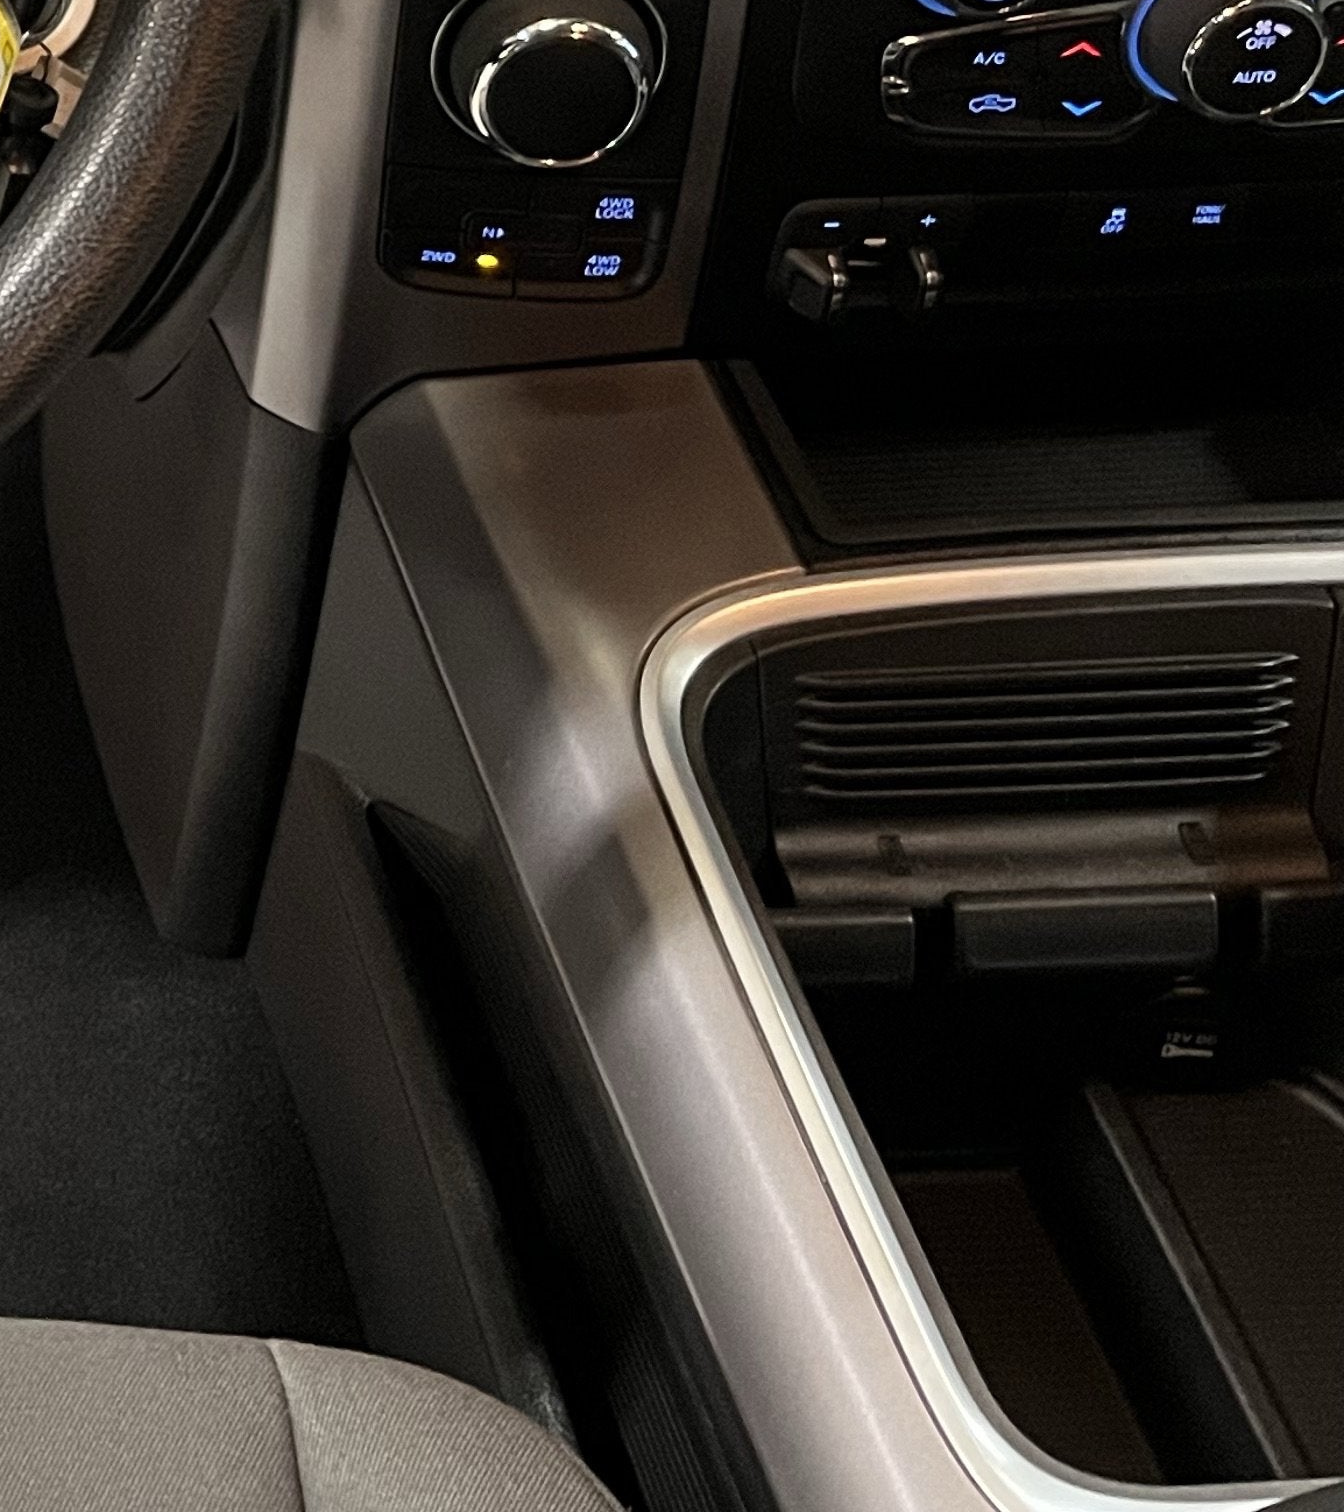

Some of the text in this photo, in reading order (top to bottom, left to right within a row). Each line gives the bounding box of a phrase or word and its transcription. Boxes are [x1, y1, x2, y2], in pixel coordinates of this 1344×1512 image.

[1244, 36, 1278, 51] OFF
[972, 50, 1006, 66] A/C
[1232, 70, 1277, 85] AUTO
[599, 196, 635, 210] 4WD
[594, 208, 635, 221] LOCK
[421, 249, 457, 264] 2WD
[586, 254, 622, 267] 4WD
[583, 264, 620, 277] LOW
